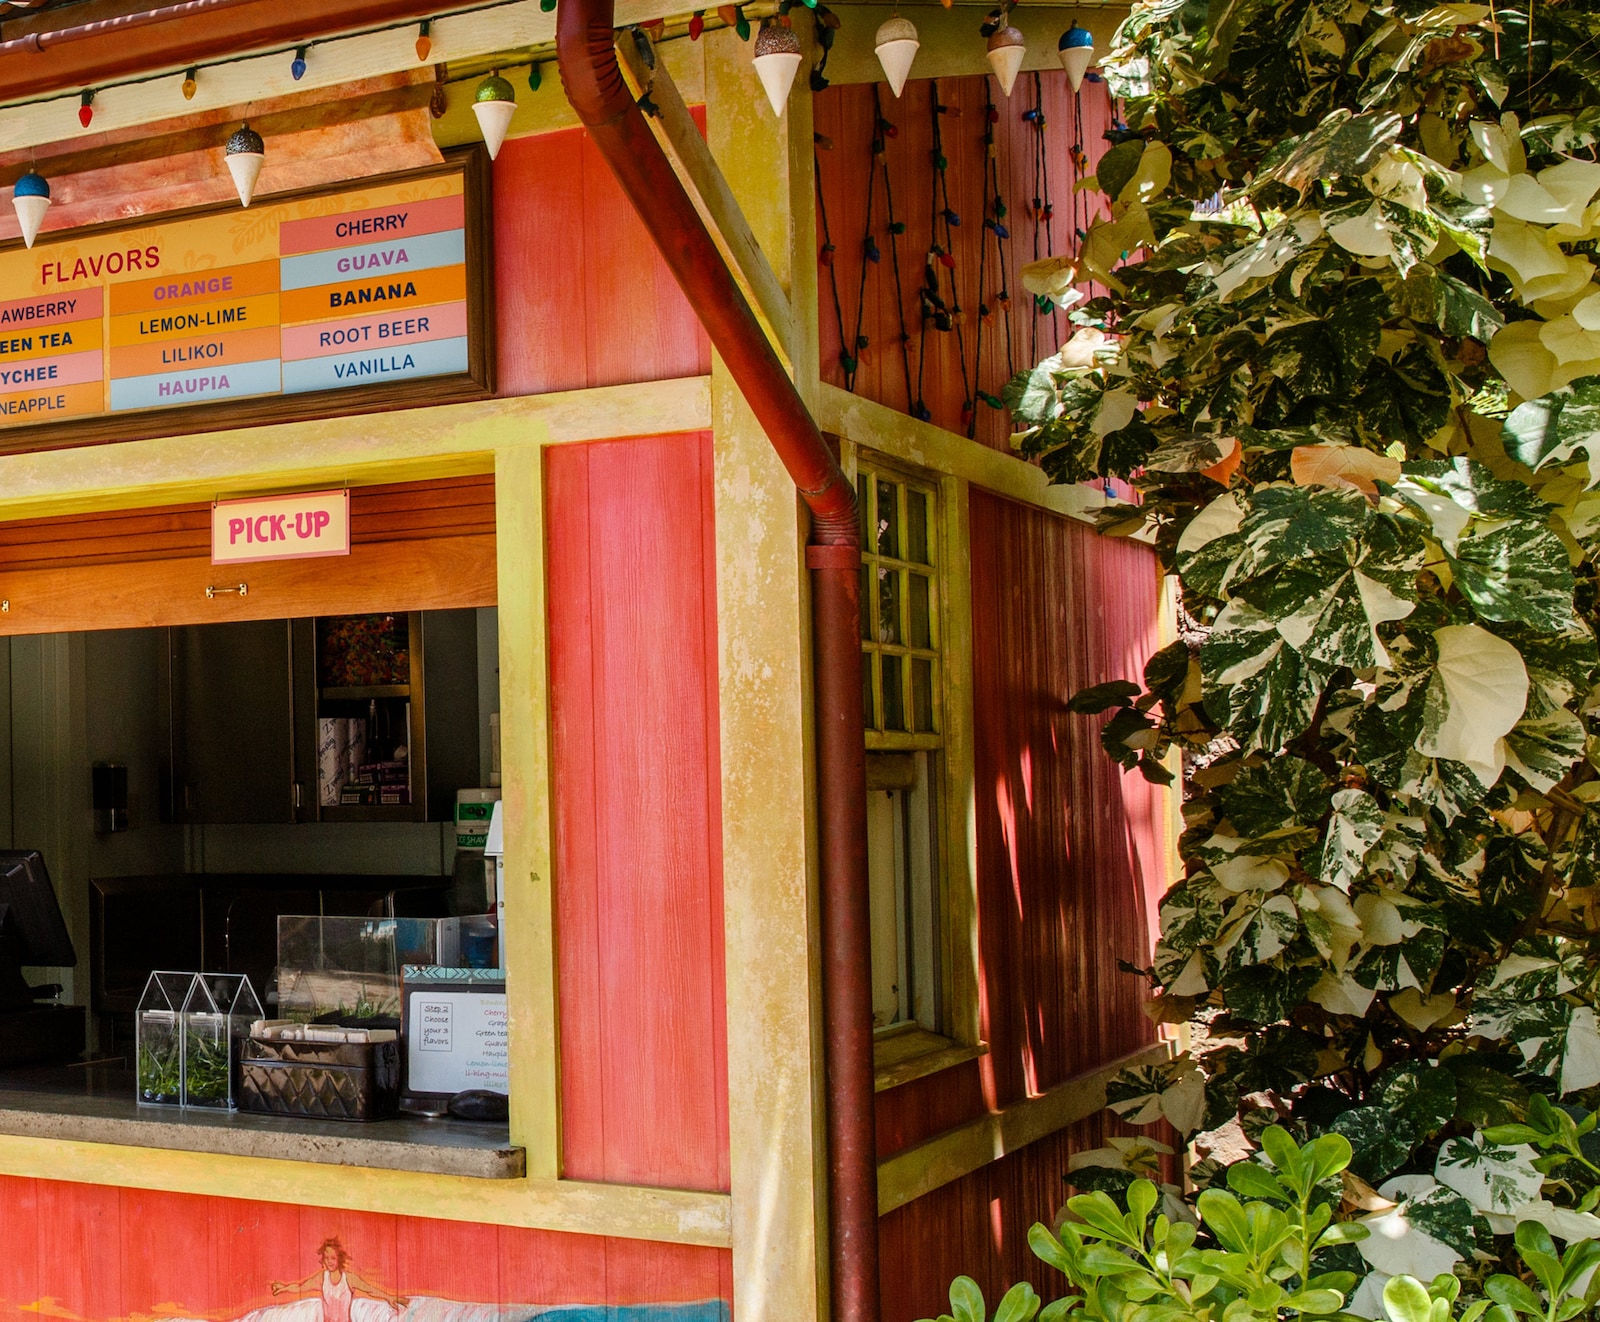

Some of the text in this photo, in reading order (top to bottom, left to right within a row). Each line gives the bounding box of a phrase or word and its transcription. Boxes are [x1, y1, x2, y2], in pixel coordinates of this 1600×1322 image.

[335, 213, 408, 238] CHERRY
[42, 246, 160, 285] FLAVORS
[336, 248, 408, 273] GUAVA
[154, 276, 233, 300] ORANGE
[330, 282, 416, 308] BANANA
[140, 306, 247, 334] LEMON-LIME
[40, 332, 73, 348] TEA
[320, 318, 430, 348] ROOT BEER
[162, 342, 224, 364] LILIKOI
[334, 354, 416, 378] VANILLA
[158, 374, 230, 397] HAUPIA
[228, 510, 330, 545] PICK-UP
